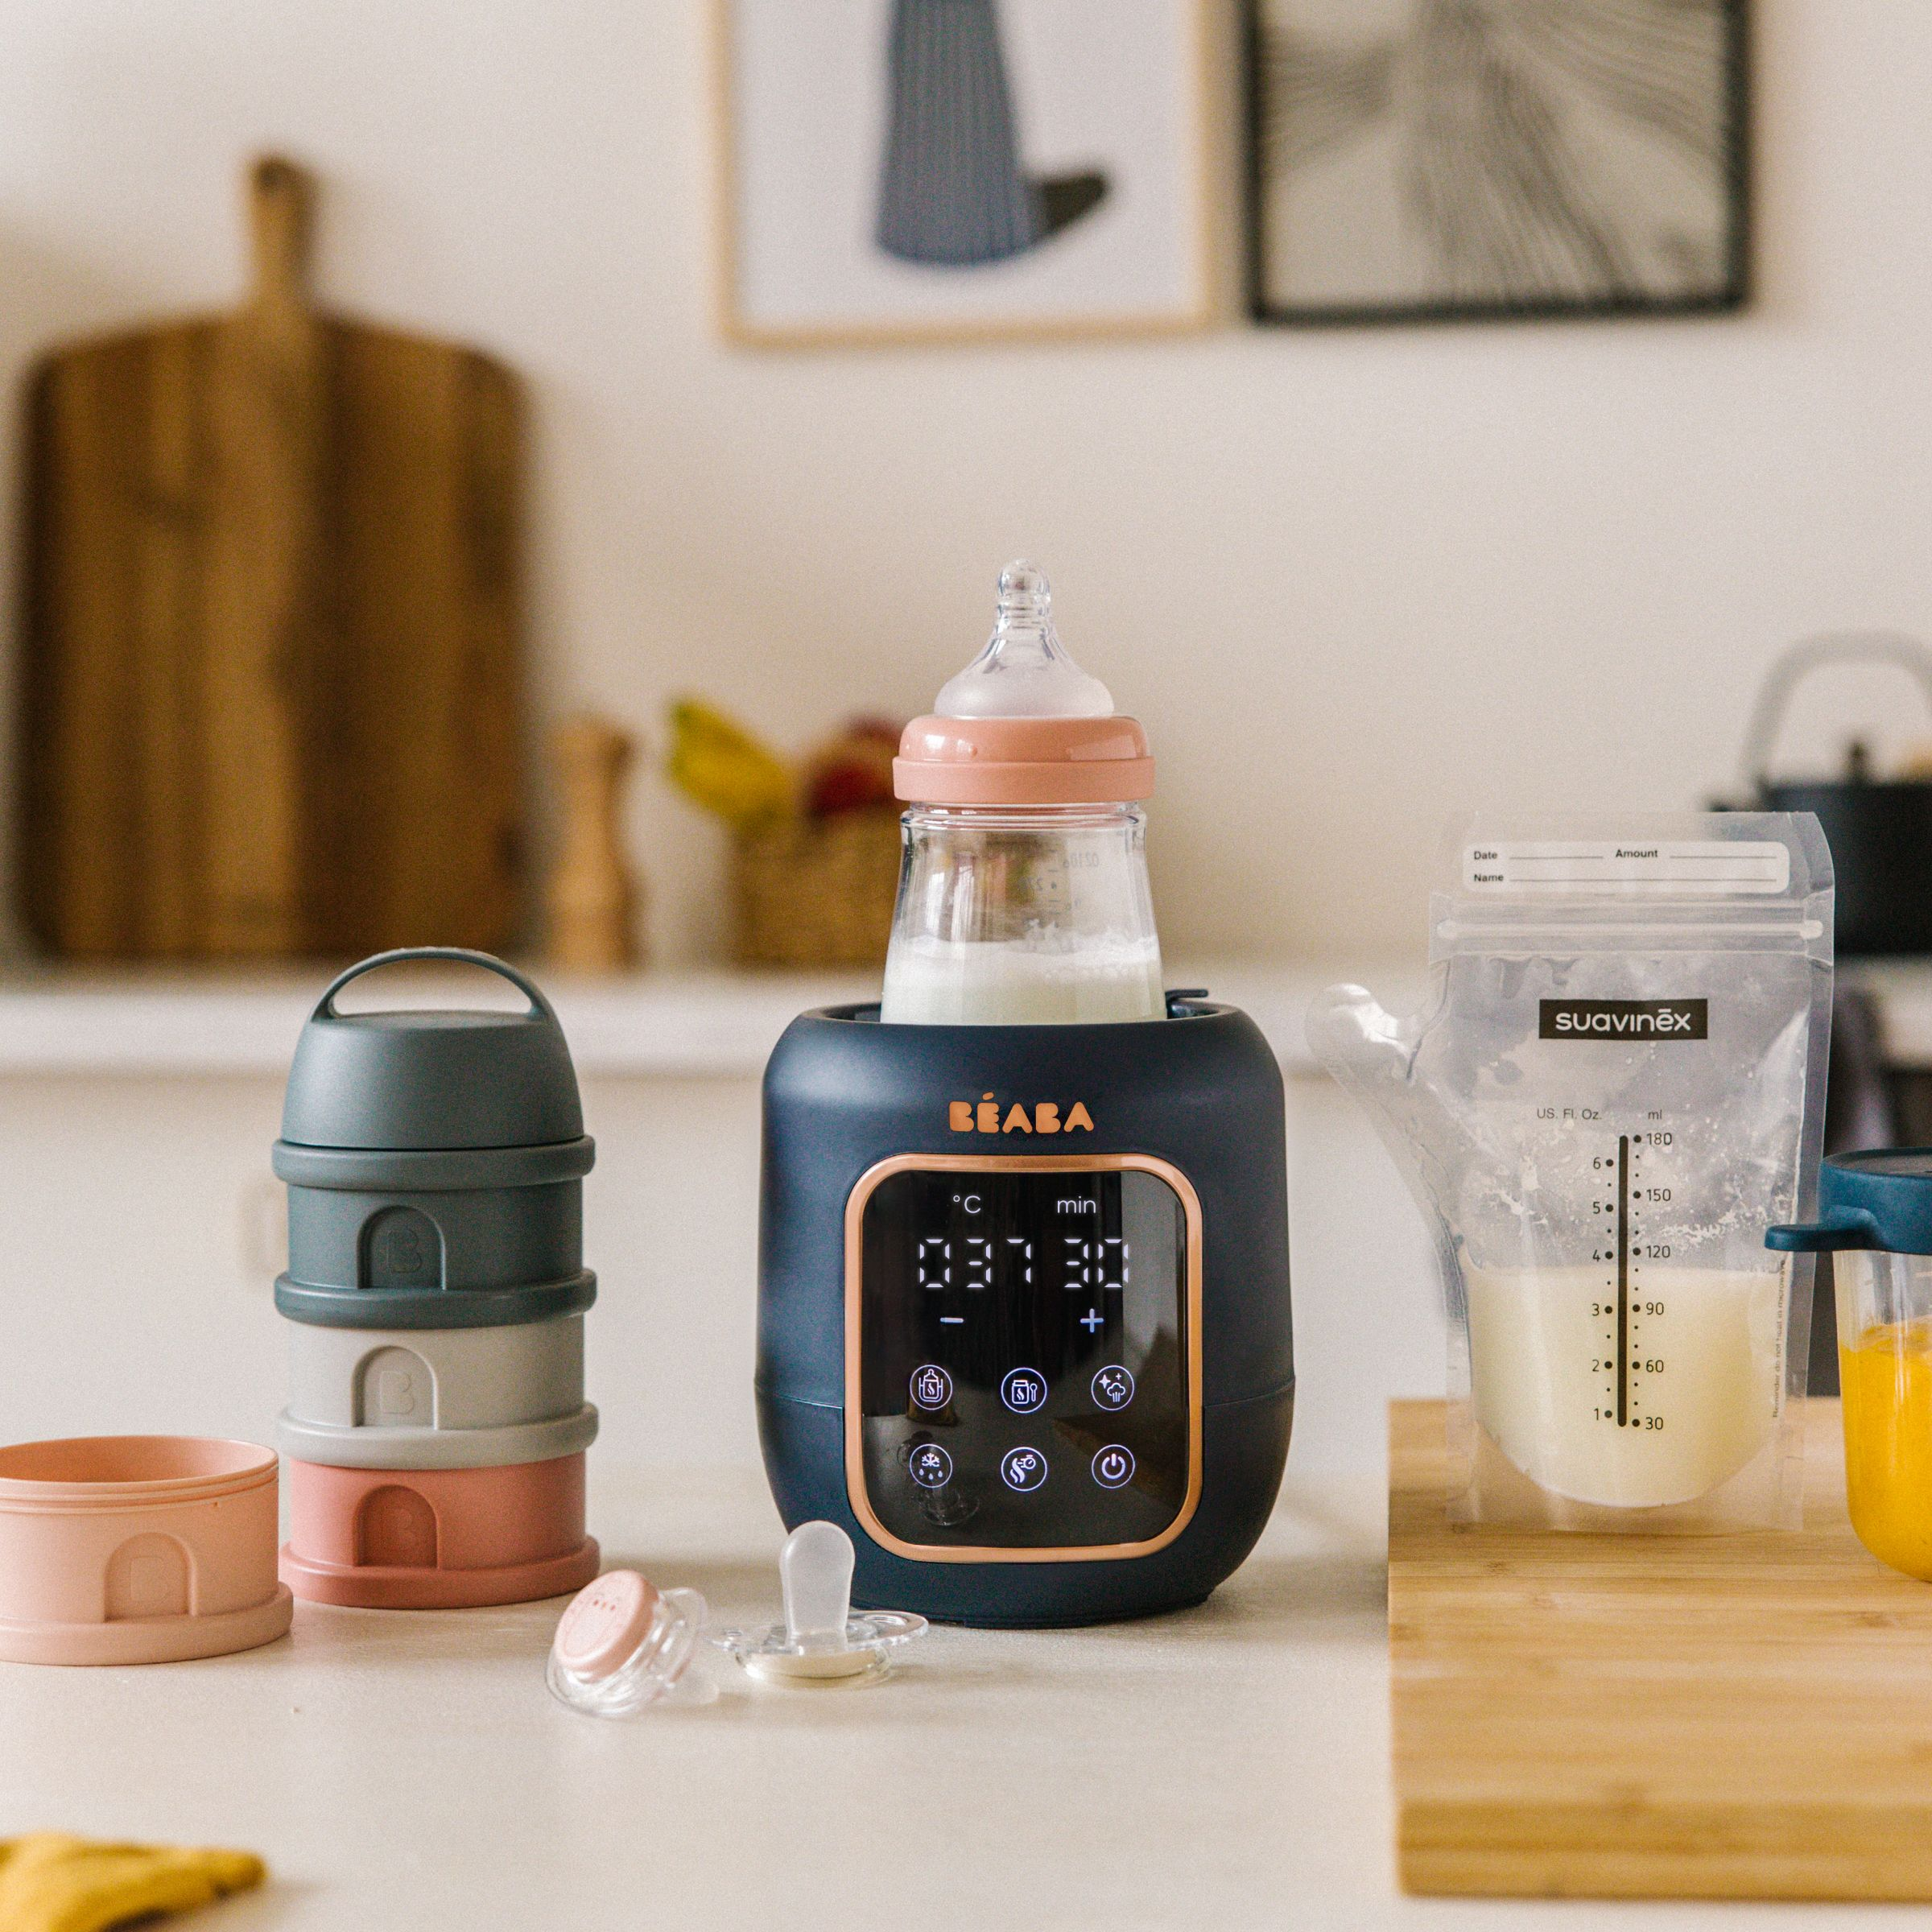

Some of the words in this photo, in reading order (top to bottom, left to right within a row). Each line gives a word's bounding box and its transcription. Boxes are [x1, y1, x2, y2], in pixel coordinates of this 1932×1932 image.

[1473, 851, 1498, 861] Date
[1615, 849, 1658, 859] Amount
[1473, 873, 1505, 882] Name
[948, 1092, 1095, 1133] BÉABA
[1536, 1108, 1558, 1120] US.
[1563, 1108, 1578, 1120] Fl.
[1581, 1108, 1602, 1121] Oz.
[1648, 1108, 1663, 1120] ml
[1646, 1132, 1674, 1146] 180
[1592, 1156, 1601, 1170] 6
[1646, 1188, 1672, 1202] 150
[953, 1195, 982, 1214] °C
[1056, 1195, 1097, 1214] min
[1592, 1201, 1600, 1215] 5
[1592, 1249, 1601, 1262] 4
[1645, 1245, 1671, 1259] 120
[919, 1238, 1032, 1289] 037
[1063, 1238, 1129, 1289] 30
[1591, 1303, 1600, 1317] 3
[1645, 1302, 1665, 1316] 90
[1591, 1359, 1600, 1373] 2
[1645, 1360, 1665, 1373] 60
[1774, 1361, 1781, 1372] do
[378, 1370, 415, 1415] B
[1773, 1376, 1781, 1418] Reminder
[1593, 1407, 1600, 1421] 1
[1645, 1416, 1664, 1430] 30
